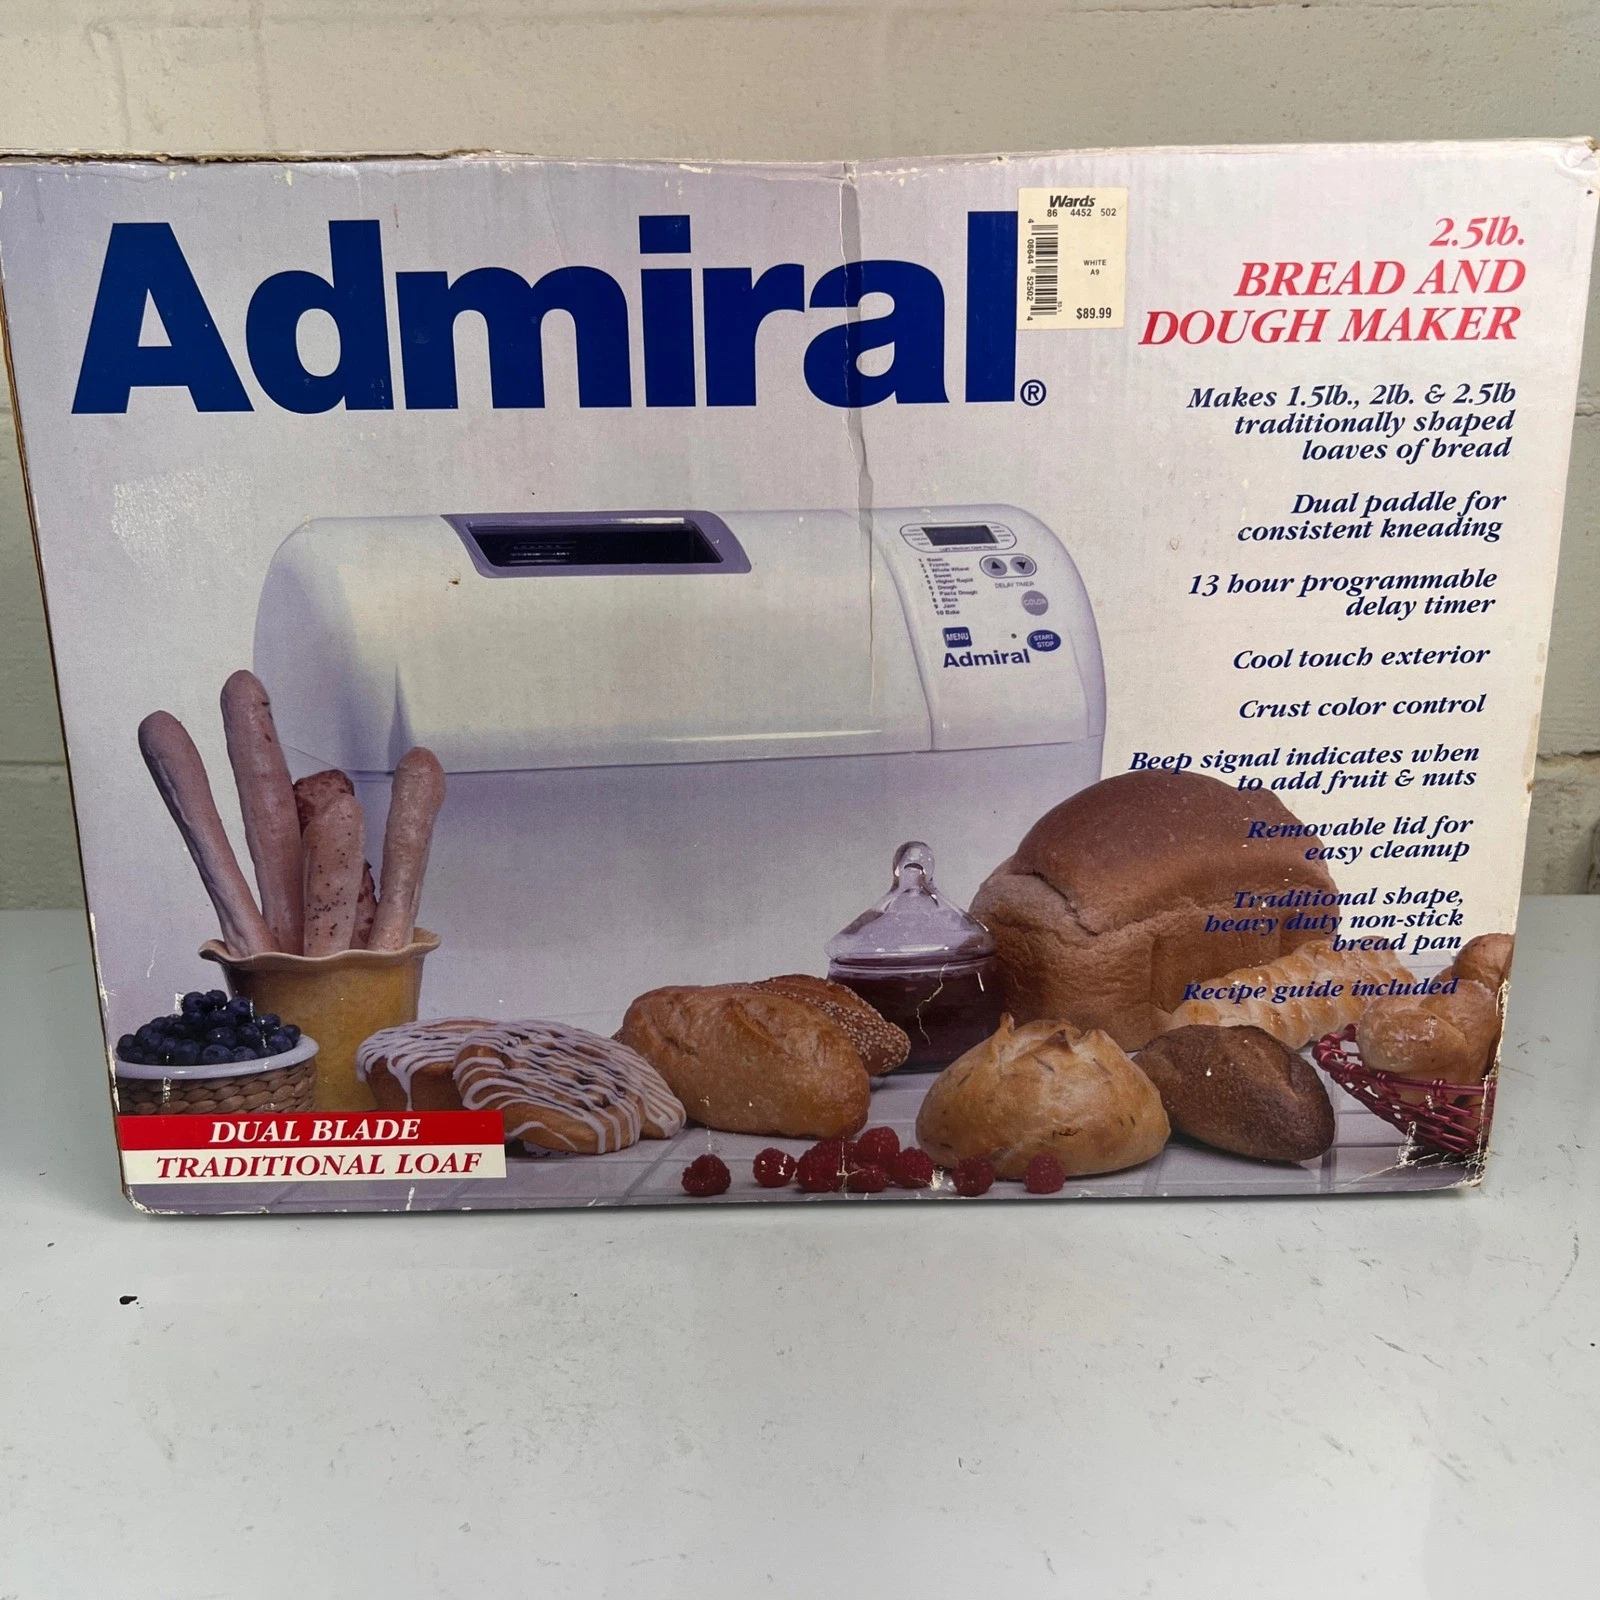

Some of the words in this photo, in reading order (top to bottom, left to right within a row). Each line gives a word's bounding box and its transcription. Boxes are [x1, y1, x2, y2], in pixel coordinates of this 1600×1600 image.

[1047, 209, 1057, 217] 86
[1100, 208, 1116, 216] 502
[1049, 195, 1095, 207] Wards
[1429, 216, 1525, 249] 2.5lb.
[1234, 260, 1406, 297] BREAD
[1414, 259, 1526, 295] AND
[71, 211, 1017, 414] Admiral
[1077, 307, 1111, 319] $89.99
[1138, 309, 1330, 345] DOUGH
[1338, 306, 1522, 342] MAKER
[1187, 386, 1277, 409] Makes
[1286, 385, 1360, 410] 1.5lb.,
[1369, 384, 1415, 407] 2lb.
[1425, 384, 1445, 404] &
[1452, 381, 1516, 404] 2.5lb
[1234, 412, 1406, 438] traditionally
[1414, 410, 1515, 437] shaped
[1302, 440, 1387, 461] loaves
[1396, 438, 1427, 465] of
[1431, 438, 1513, 458] bread
[1291, 493, 1359, 514] Dual
[1360, 491, 1457, 519] paddle
[1457, 490, 1507, 517] for
[1238, 519, 1373, 541] consistent
[1380, 517, 1503, 543] kneading
[1189, 574, 1218, 596] 13
[1227, 573, 1294, 594] hour
[1297, 568, 1497, 598] programmable
[1346, 596, 1417, 621] delay
[1424, 596, 1495, 615] timer
[946, 633, 969, 641] MENU
[943, 649, 1030, 668] Admiral
[1233, 648, 1291, 670] Cool
[1299, 646, 1373, 667] touch
[1381, 645, 1491, 666] exterior
[1239, 699, 1310, 719] Crust
[1318, 696, 1386, 717] color
[1393, 695, 1487, 714] control
[1129, 751, 1192, 775] Beep
[1200, 747, 1281, 773] signal
[1286, 746, 1403, 766] indicates
[1411, 744, 1480, 763] when
[1238, 774, 1263, 792] to
[1271, 771, 1322, 791] add
[1322, 769, 1388, 795] fruit
[1395, 769, 1415, 788] &
[1422, 769, 1477, 787] nuts
[1246, 817, 1386, 839] Removable
[1393, 816, 1427, 835] lid
[1428, 815, 1474, 840] for
[1305, 844, 1363, 865] easy
[1370, 840, 1470, 863] cleanup
[1233, 888, 1377, 911] Traditional
[1383, 886, 1464, 909] shape,
[1205, 914, 1278, 936] heavy
[1286, 912, 1343, 935] duty
[1349, 909, 1464, 929] non-stick
[1332, 934, 1405, 953] bread
[1410, 936, 1462, 956] pan
[1183, 982, 1268, 1004] Recipe
[1272, 980, 1344, 1004] guide
[1351, 978, 1459, 997] included
[209, 1120, 301, 1144] DUAL
[310, 1119, 421, 1142] BLADE
[157, 1154, 385, 1178] TRADITIONAL
[395, 1152, 482, 1174] LOAF
